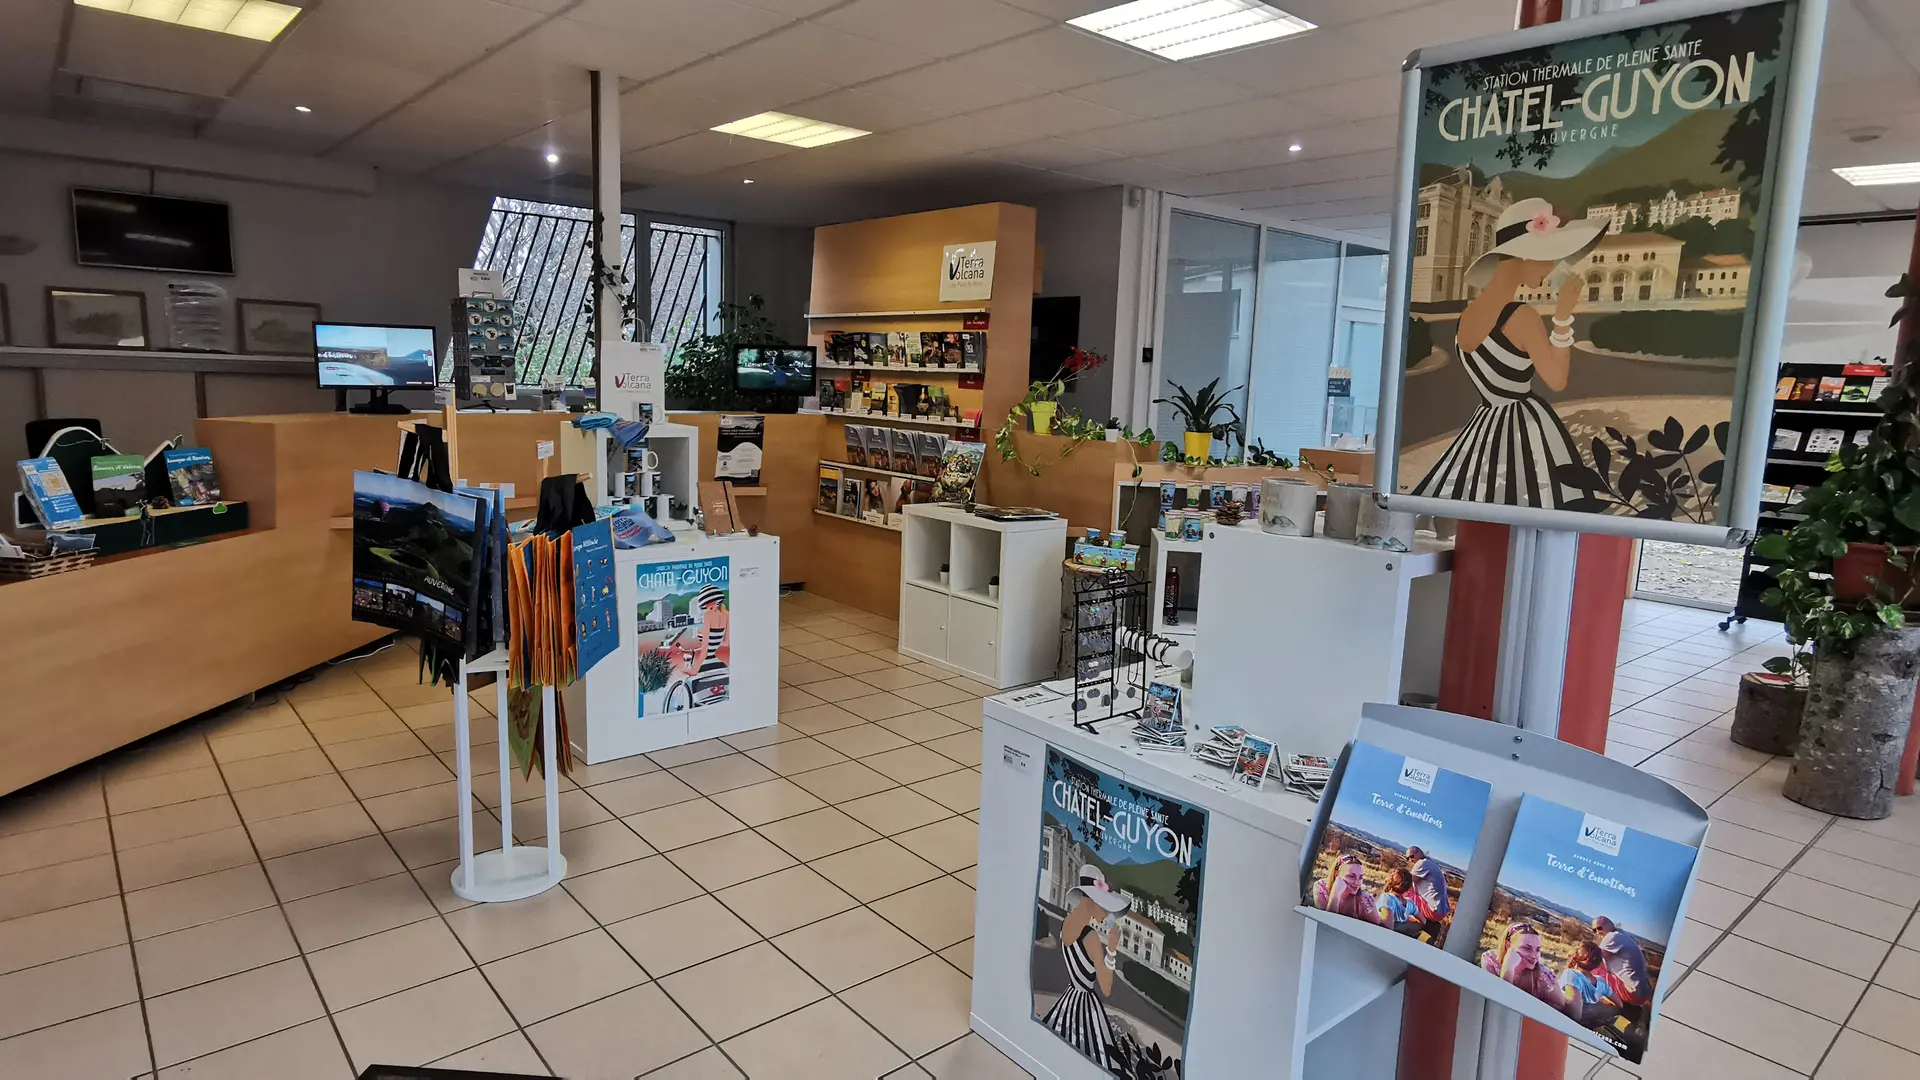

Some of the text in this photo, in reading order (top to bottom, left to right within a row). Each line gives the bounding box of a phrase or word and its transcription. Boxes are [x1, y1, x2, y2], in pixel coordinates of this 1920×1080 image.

[1483, 70, 1528, 91] STATION
[1532, 58, 1592, 82] THERMALE
[1596, 55, 1613, 72] DE
[1617, 47, 1660, 68] PLEINE
[1438, 51, 1755, 142] CHATEL-GUYON
[1539, 124, 1619, 146] AUVERGNE
[949, 257, 985, 280] Volcana
[960, 256, 984, 269] Terra
[614, 373, 652, 389] Volcana
[625, 372, 650, 382] Terra
[638, 565, 728, 589] CHATEL-GUYON
[1404, 768, 1431, 786] Volcana
[1414, 768, 1431, 780] Terra
[1070, 776, 1091, 794] STATION
[1090, 785, 1118, 807] THERMALE
[1118, 800, 1128, 809] DE
[1128, 803, 1150, 819] PLEINE
[1371, 792, 1395, 810] Terre
[1052, 780, 1193, 867] CHATEL-GUYON
[1595, 826, 1617, 840] Terra
[1584, 826, 1617, 847] Volcana
[1546, 852, 1636, 898] Terre d'émotions
